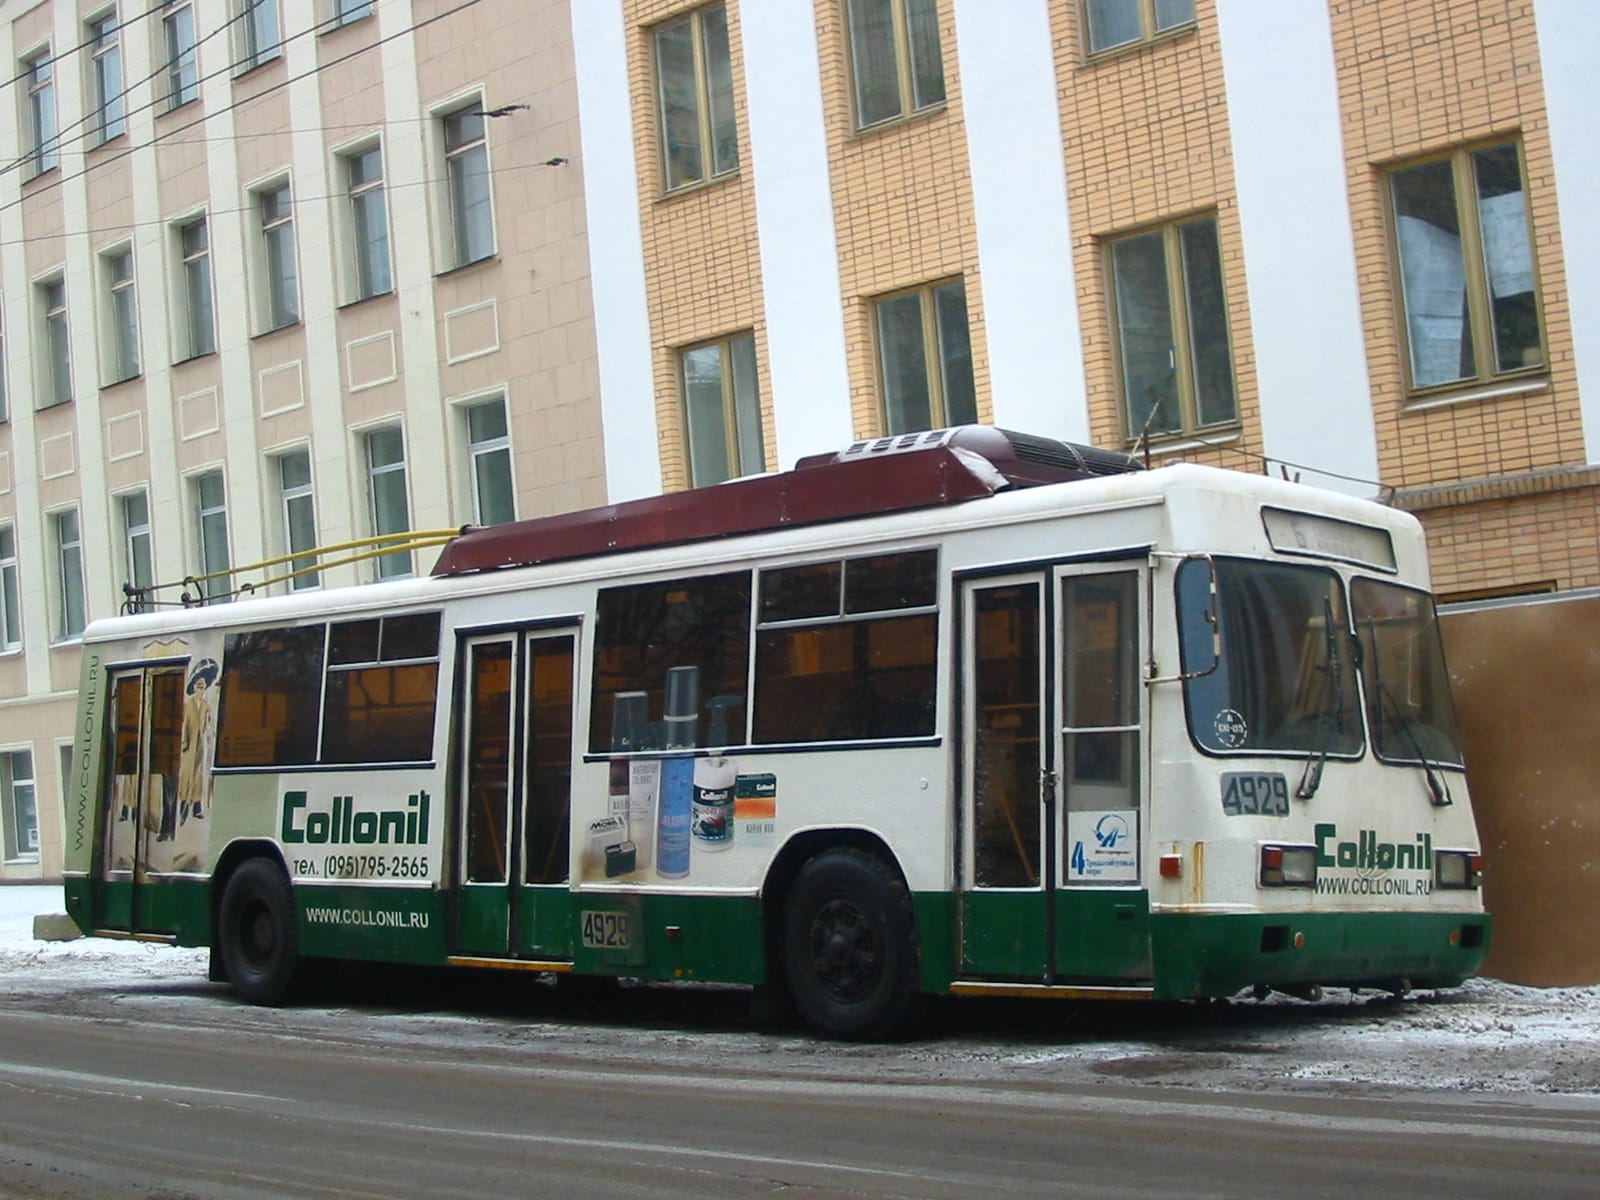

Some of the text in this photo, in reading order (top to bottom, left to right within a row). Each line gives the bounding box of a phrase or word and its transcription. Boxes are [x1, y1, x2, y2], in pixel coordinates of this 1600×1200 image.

[75, 655, 99, 851] WWW.COLLONIL.RU
[1223, 776, 1290, 815] 4929
[282, 790, 431, 844] Collonil
[1071, 841, 1085, 875] 4
[1314, 823, 1431, 870] Collonil
[293, 855, 429, 879] тел. (095)795-2565
[1314, 877, 1432, 896] WWW.COLLONIL.RU
[306, 907, 430, 929] WWW.COLLONIL.RU
[583, 913, 629, 946] 4929
